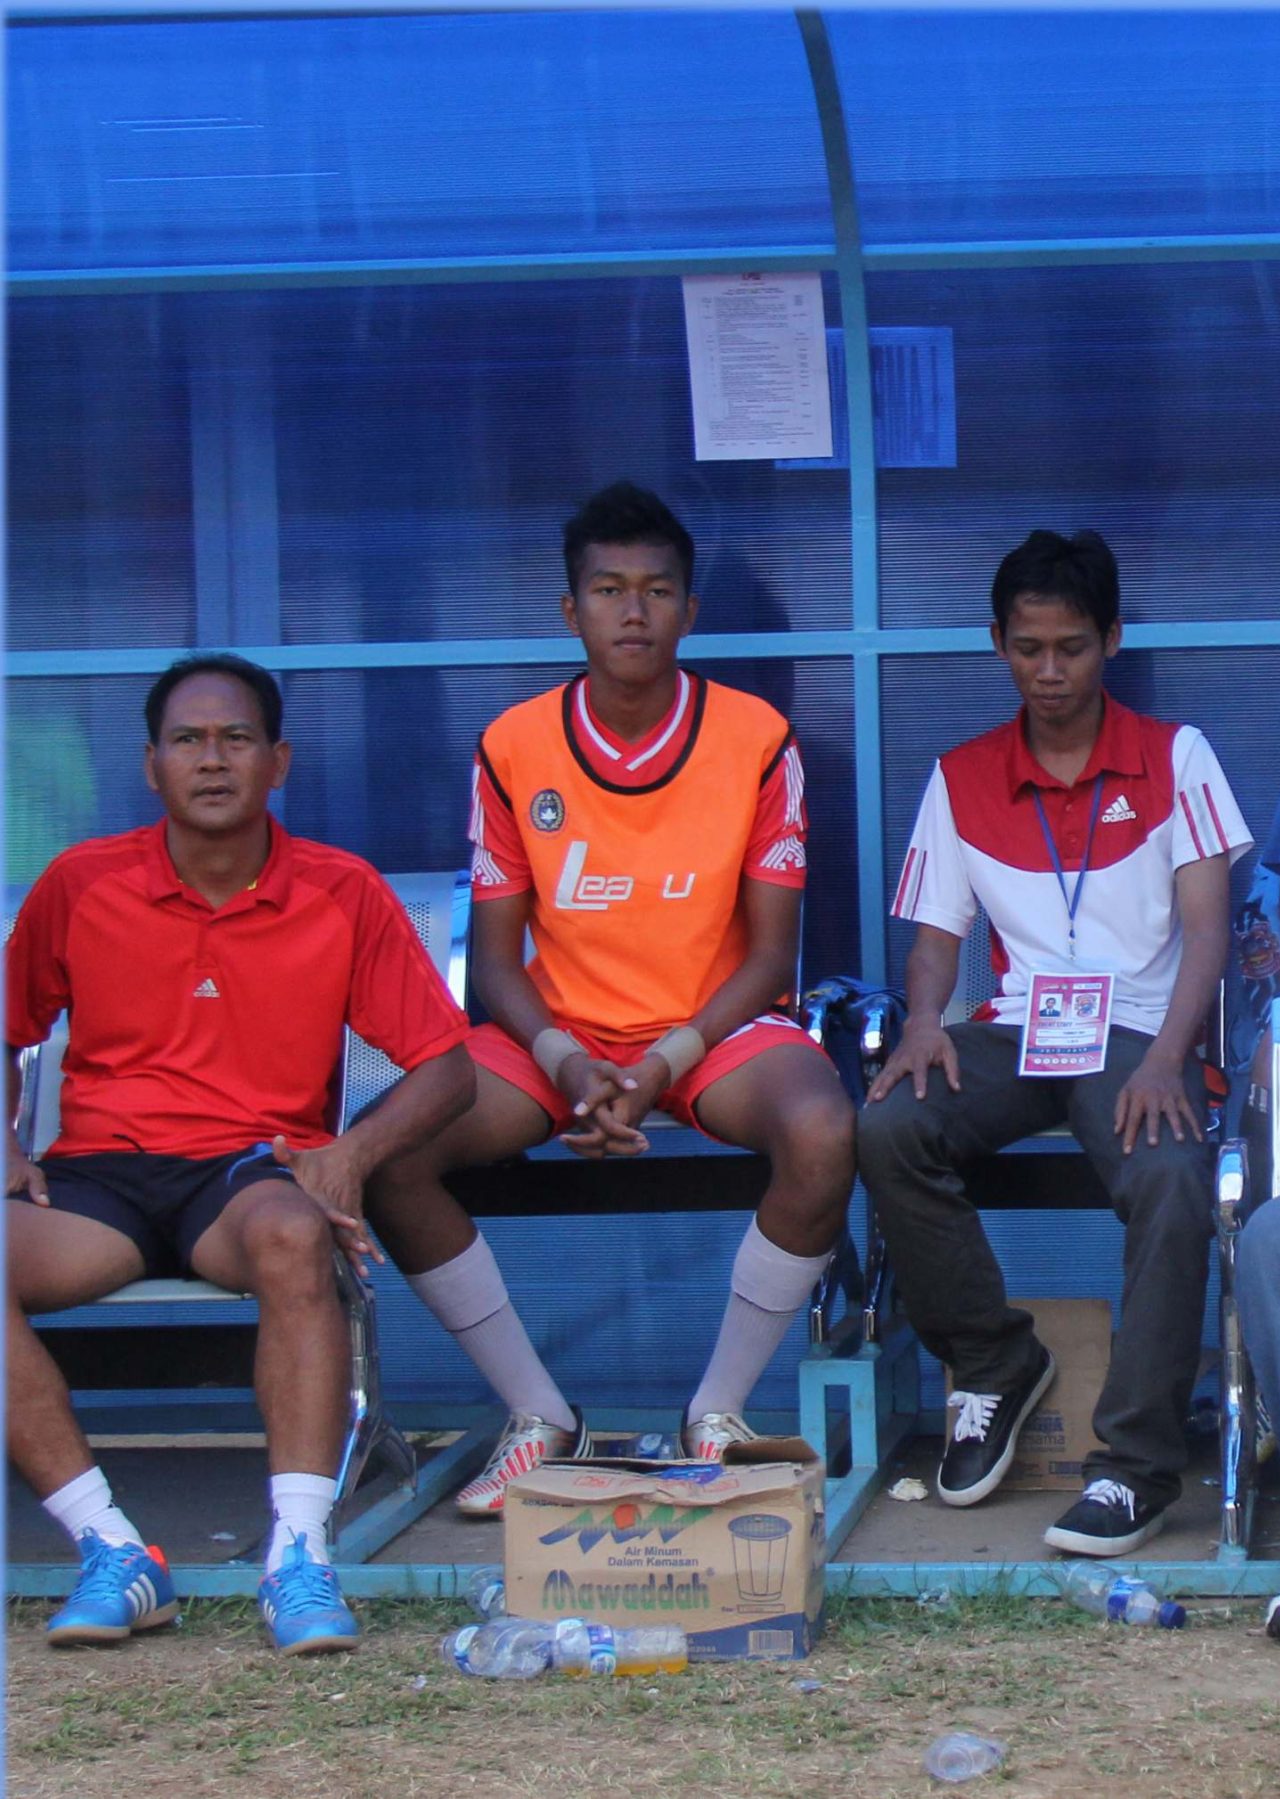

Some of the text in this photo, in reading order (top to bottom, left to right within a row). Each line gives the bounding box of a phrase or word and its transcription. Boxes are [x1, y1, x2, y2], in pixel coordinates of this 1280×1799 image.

[624, 1546, 682, 1556] Air Minum
[607, 1556, 699, 1567] Dalam Kemasan
[543, 1569, 709, 1610] Mawaddah
